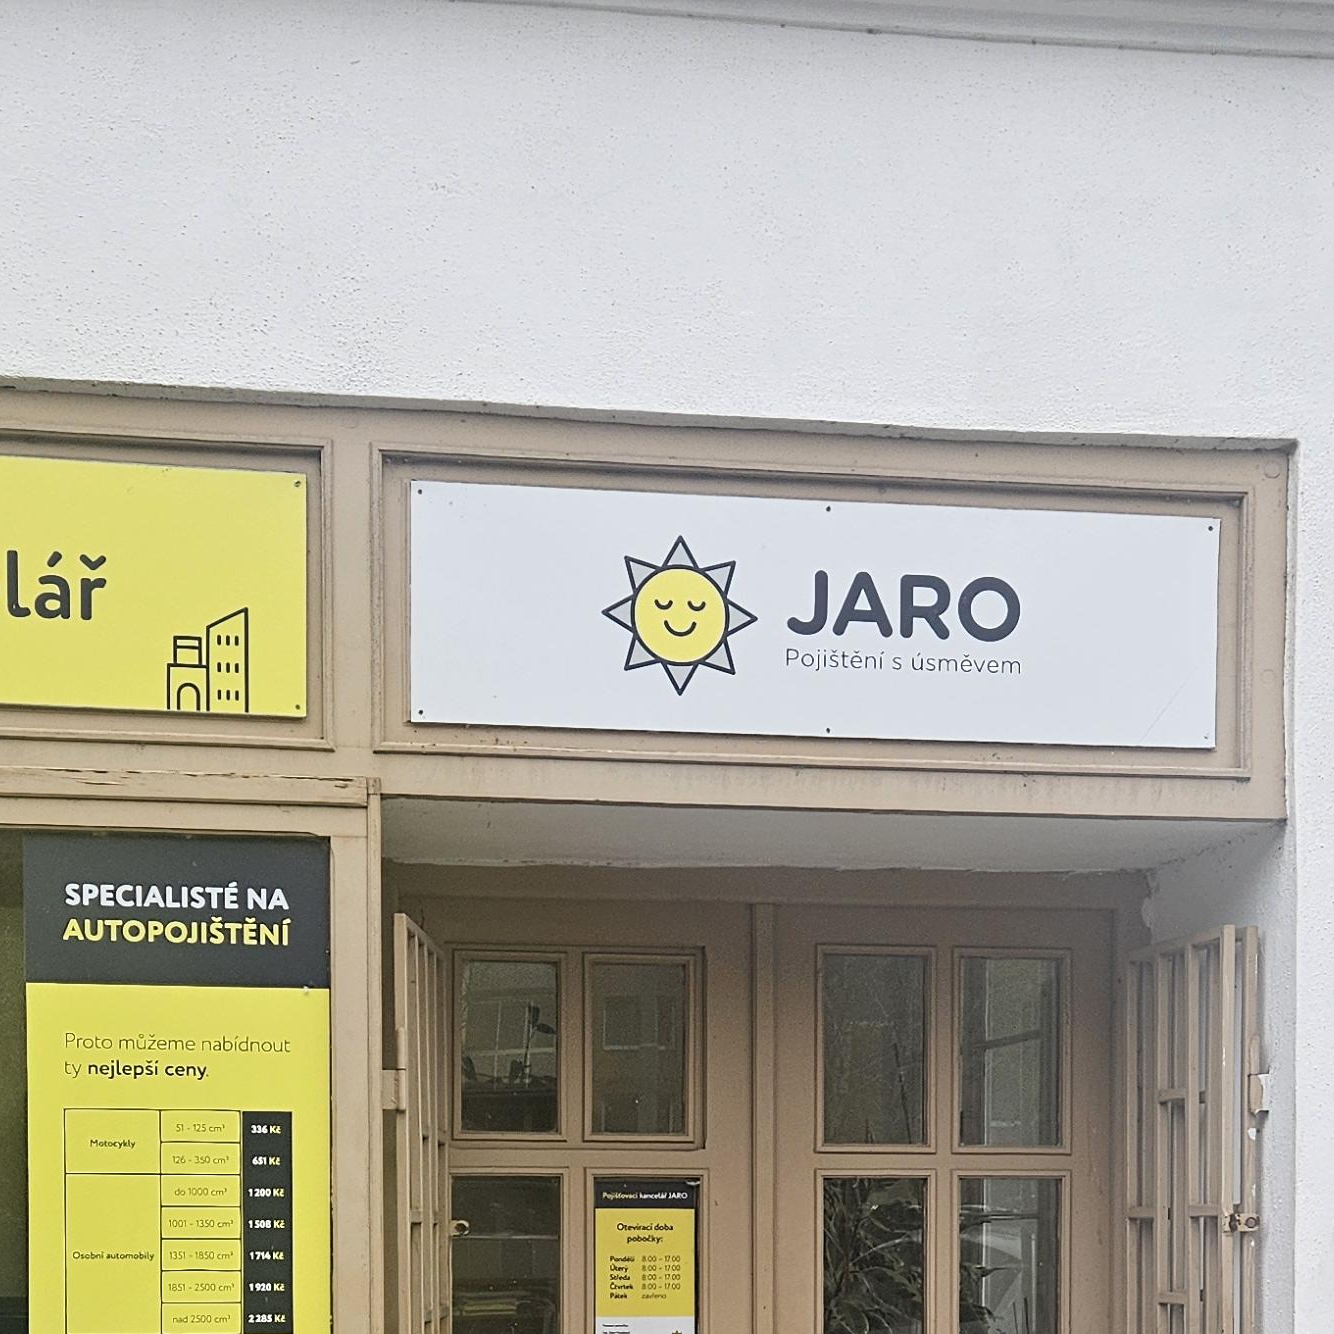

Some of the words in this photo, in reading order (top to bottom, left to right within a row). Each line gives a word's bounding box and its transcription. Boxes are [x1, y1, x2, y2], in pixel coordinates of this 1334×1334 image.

[786, 569, 1022, 643] JARO
[785, 647, 885, 674] Pojištění
[892, 655, 903, 672] s
[910, 648, 1022, 675] úsměvem
[64, 881, 240, 909] SPECIALISTÉ
[247, 887, 290, 910] NA
[62, 916, 292, 946] AUTOPOJIŠTĚNÍ
[64, 1032, 113, 1050] Proto
[118, 1033, 196, 1052] můžeme
[201, 1035, 292, 1053] nabídnout
[64, 1061, 82, 1078] ty
[87, 1059, 159, 1080] nejlepší
[164, 1064, 209, 1080] ceny.
[250, 1125, 268, 1134] 336
[269, 1125, 282, 1134] Kč
[90, 1139, 136, 1150] Motocykly
[252, 1156, 267, 1165] 651
[269, 1156, 281, 1165] Kč
[273, 1188, 285, 1197] Kč
[273, 1219, 285, 1229] Kč
[654, 1222, 674, 1231] doba
[627, 1234, 663, 1244] pobočky:
[72, 1251, 104, 1260] Osobní
[106, 1251, 155, 1262] automobily
[272, 1251, 284, 1260] Kč
[273, 1283, 285, 1292] Kč
[274, 1314, 286, 1323] Kč
